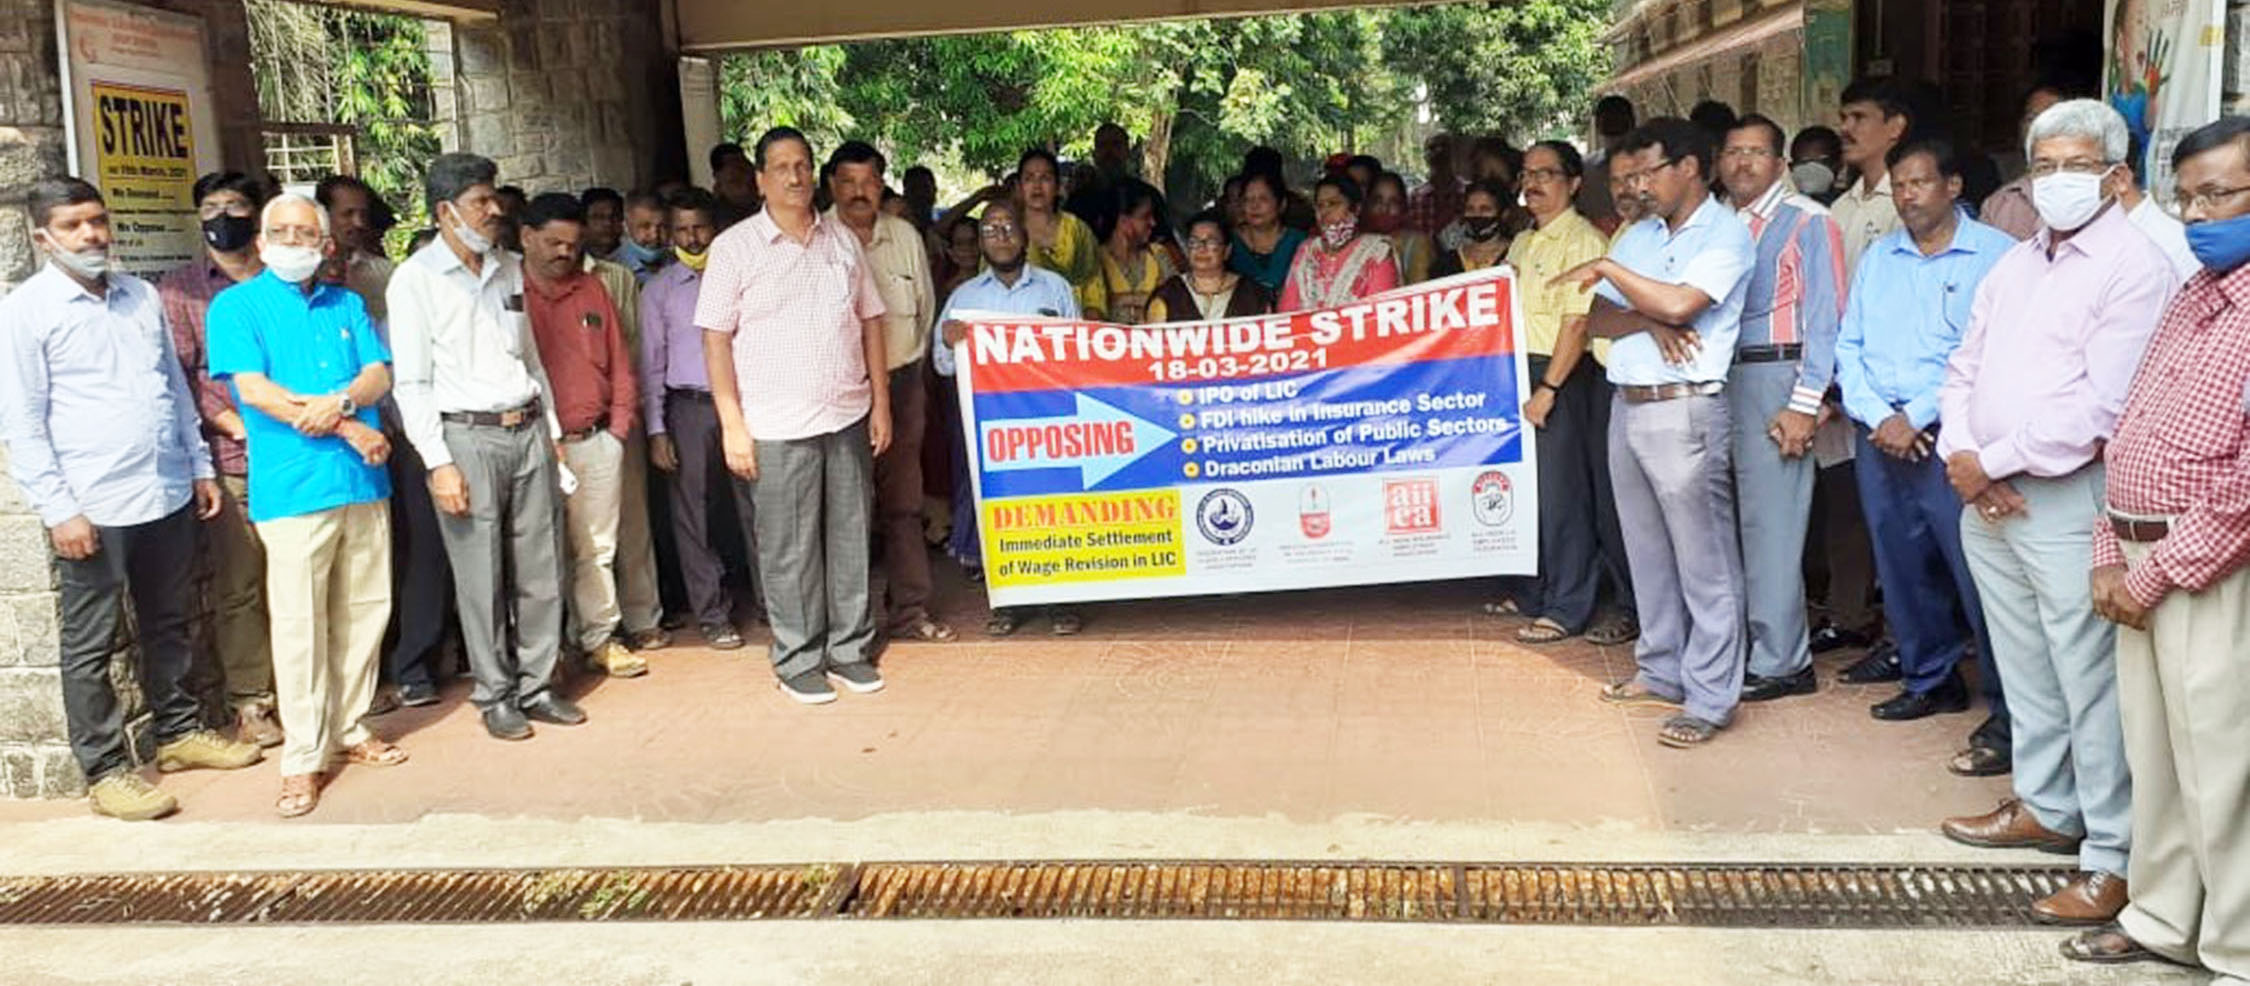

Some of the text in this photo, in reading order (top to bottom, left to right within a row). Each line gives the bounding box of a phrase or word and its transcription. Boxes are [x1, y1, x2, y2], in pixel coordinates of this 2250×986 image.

[99, 95, 188, 158] STRIKE
[973, 283, 1499, 365] NATIONWIDE STRIKE
[1148, 348, 1327, 381] 18-03-2021
[1199, 381, 1298, 404] IPO of LIC
[1201, 392, 1486, 429] FDI hike in Insurance Sector
[988, 421, 1135, 462] OPPOSING
[1203, 417, 1508, 453] Privatisation of Public Sectors
[1205, 447, 1435, 476] Draconian Labour Laws
[993, 494, 1175, 530] DEMANDING
[1000, 529, 1173, 553] Immediate Settlement
[1000, 551, 1177, 576] of Wage Revision in LIC
